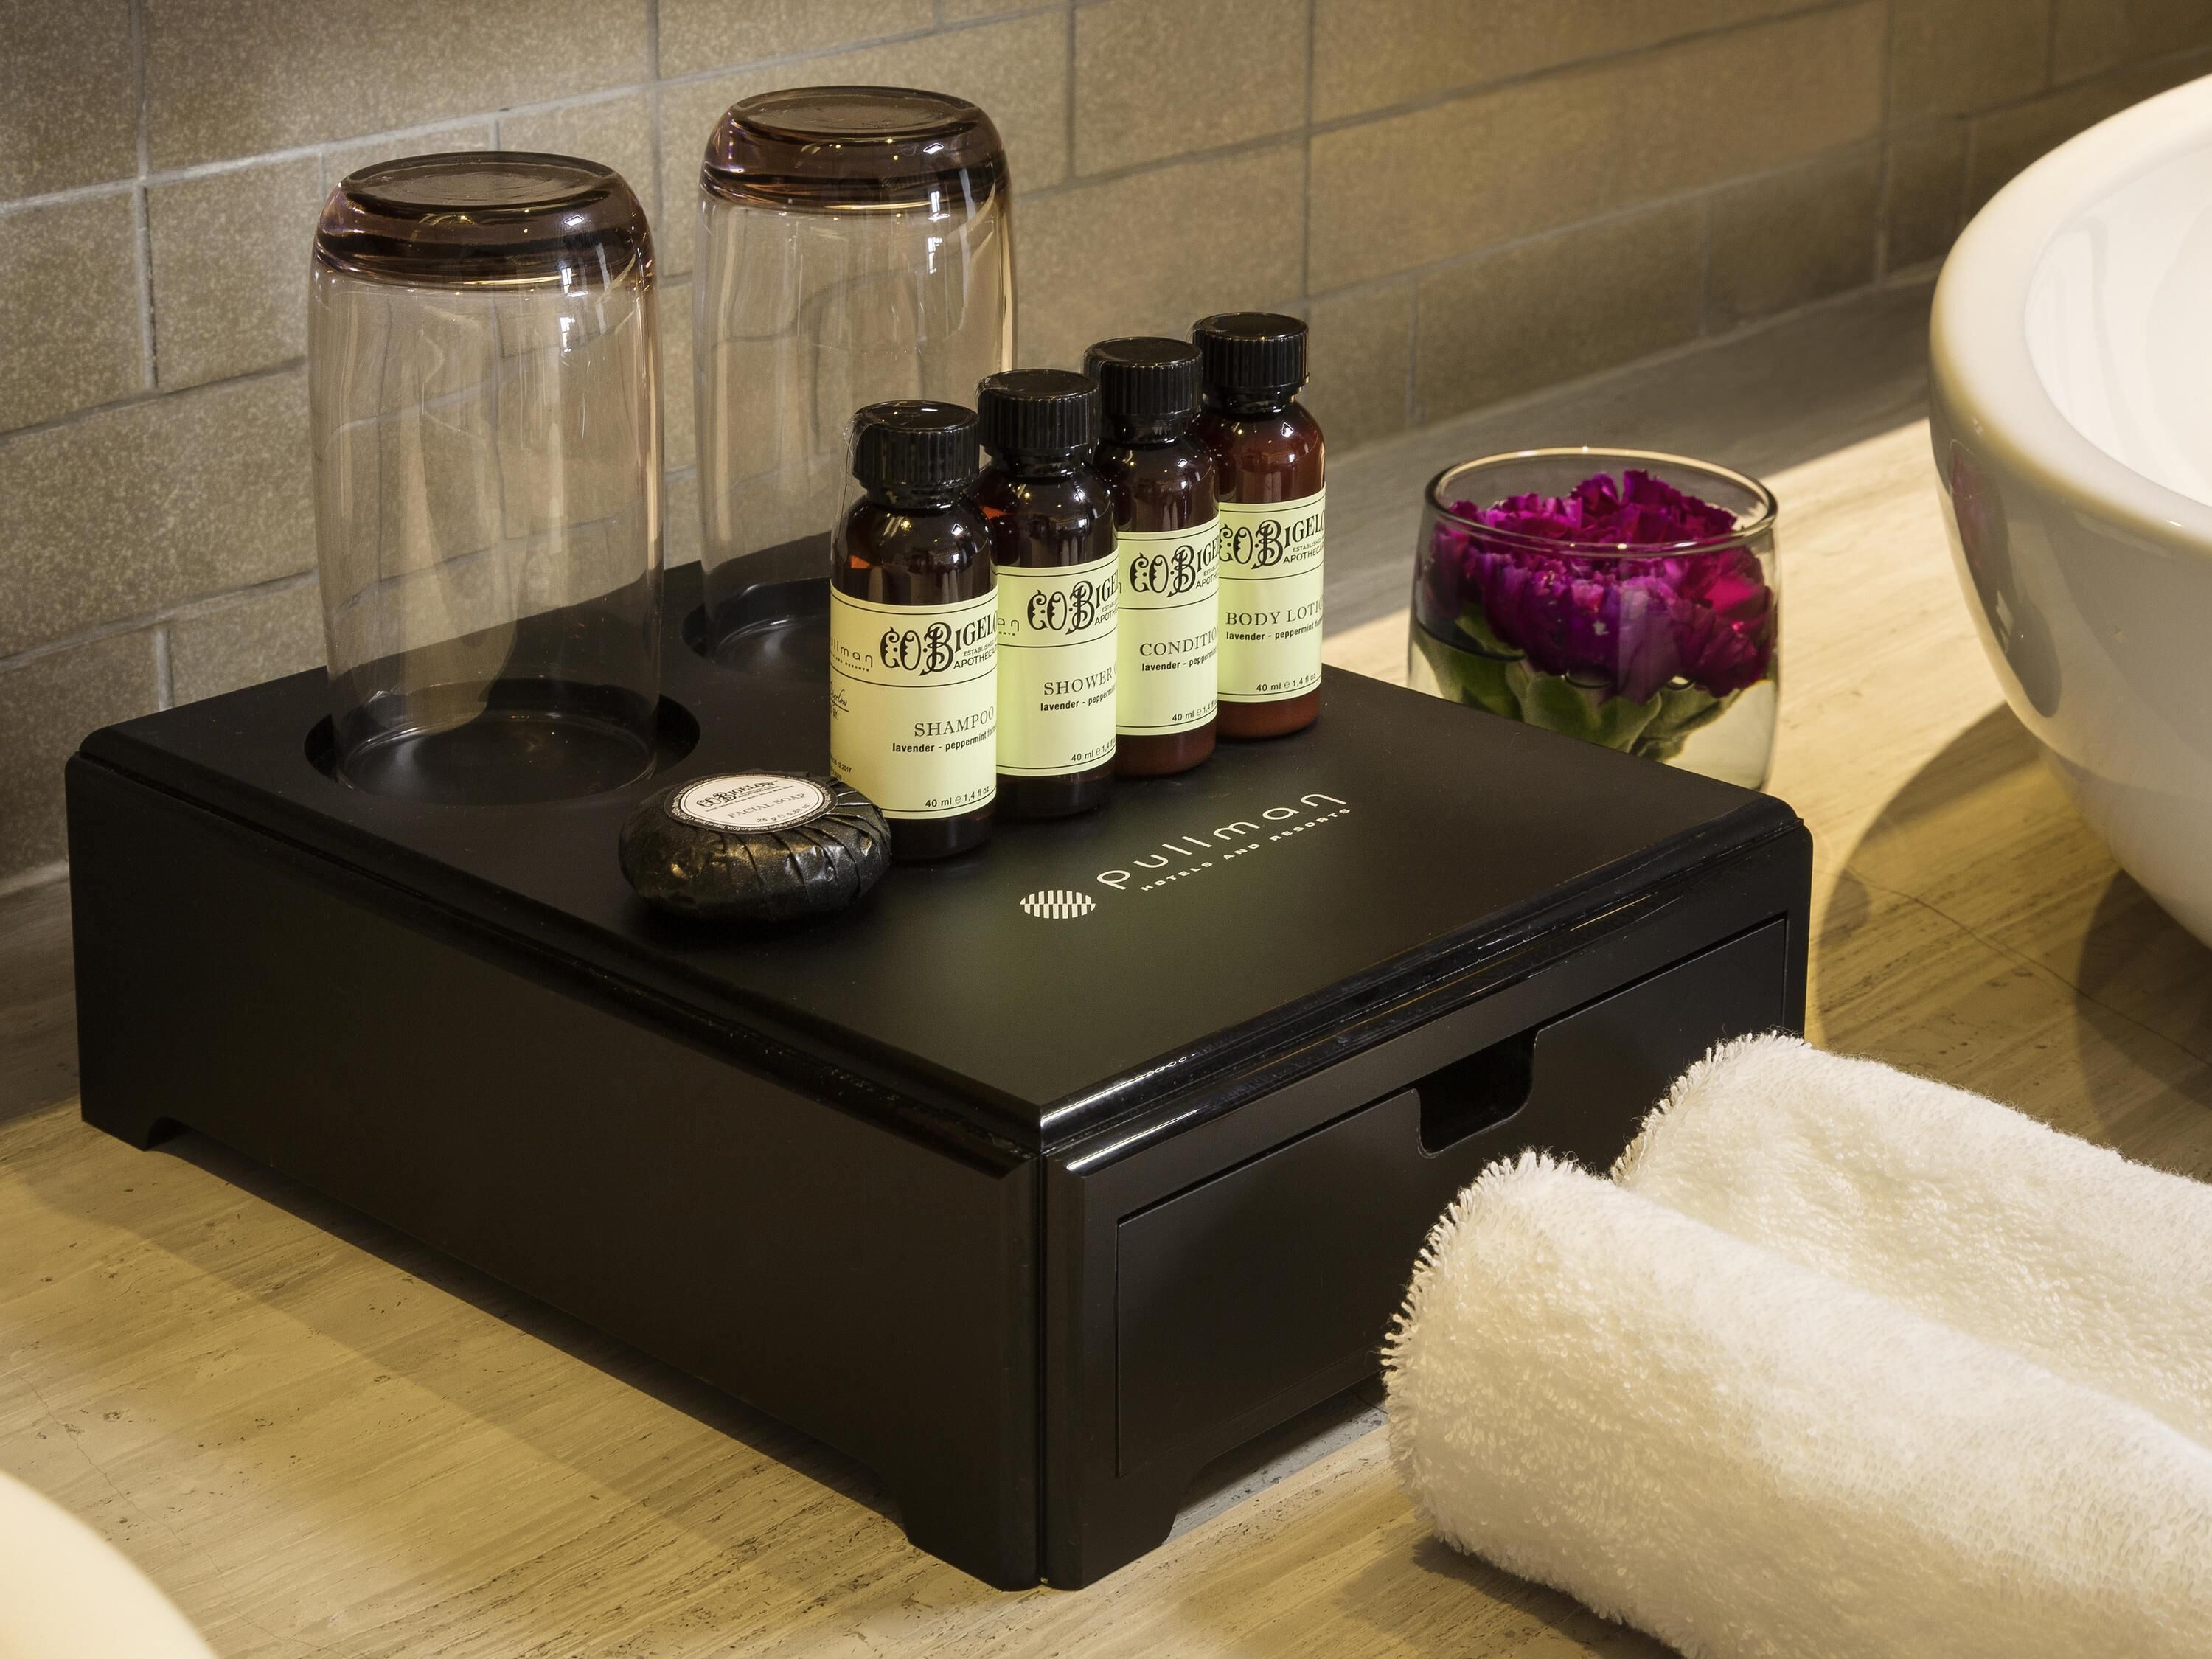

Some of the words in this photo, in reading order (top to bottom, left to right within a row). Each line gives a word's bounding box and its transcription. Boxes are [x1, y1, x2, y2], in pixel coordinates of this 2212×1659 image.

[1225, 611, 1281, 626] BODY
[1226, 631, 1265, 641] lavender
[1275, 622, 1314, 640] peppermint
[1141, 661, 1180, 672] lavender
[1044, 667, 1112, 696] SHOWER
[1256, 684, 1267, 692] 40
[1270, 682, 1281, 691] ml
[1040, 700, 1079, 712] lavender
[914, 706, 994, 737] SHAMPOO
[1172, 713, 1183, 721] 40
[1186, 710, 1194, 720] ml
[892, 742, 935, 753] lavender
[945, 730, 987, 752] peppermint
[1071, 754, 1082, 762] 40
[1085, 750, 1093, 759] ml
[925, 799, 938, 808] 40
[941, 797, 952, 807] ml
[1097, 793, 1347, 890] pullman
[1140, 861, 1213, 891] HOTELS
[1223, 844, 1260, 860] AND
[1269, 808, 1350, 841] RESORTS
